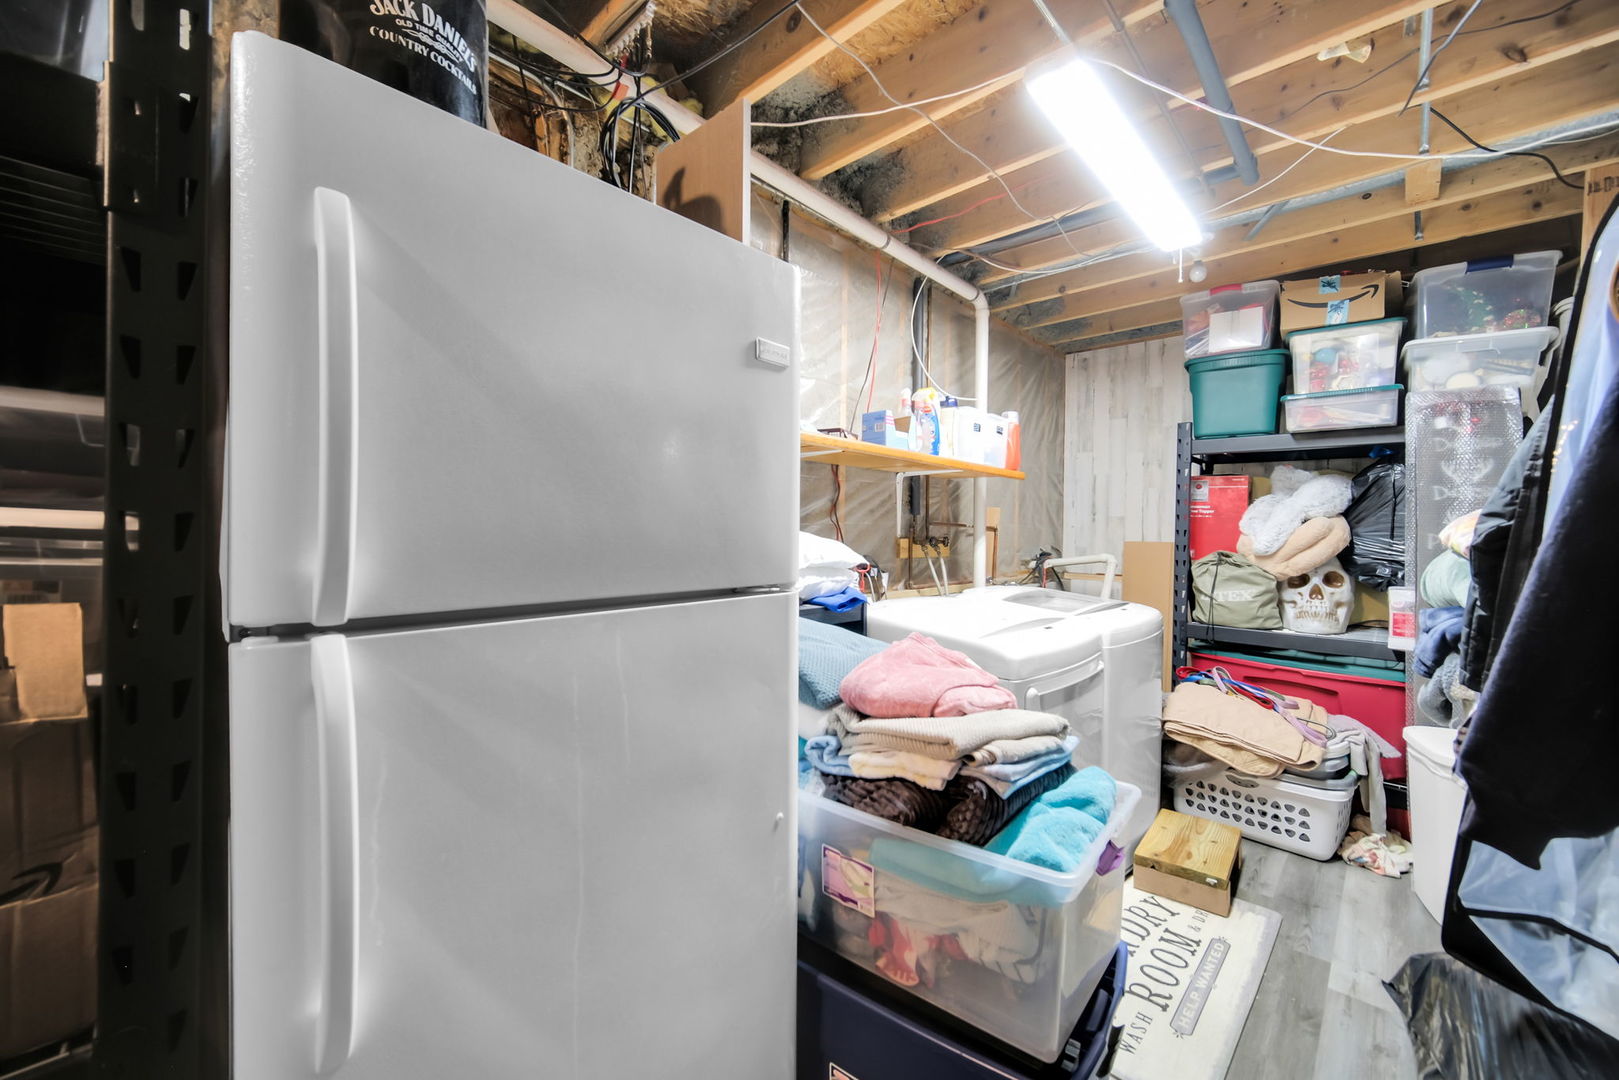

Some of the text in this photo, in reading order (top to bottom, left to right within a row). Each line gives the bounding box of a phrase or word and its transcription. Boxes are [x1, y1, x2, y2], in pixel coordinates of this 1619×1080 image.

[369, 0, 419, 21] JACK
[395, 18, 414, 28] OLD
[415, 22, 434, 38] TIME
[369, 25, 477, 95] COUNTRY COCKTAILS
[1125, 927, 1202, 1012] ROOM
[1178, 942, 1225, 1029] HELP WANTED
[1119, 1011, 1153, 1055] WASH
